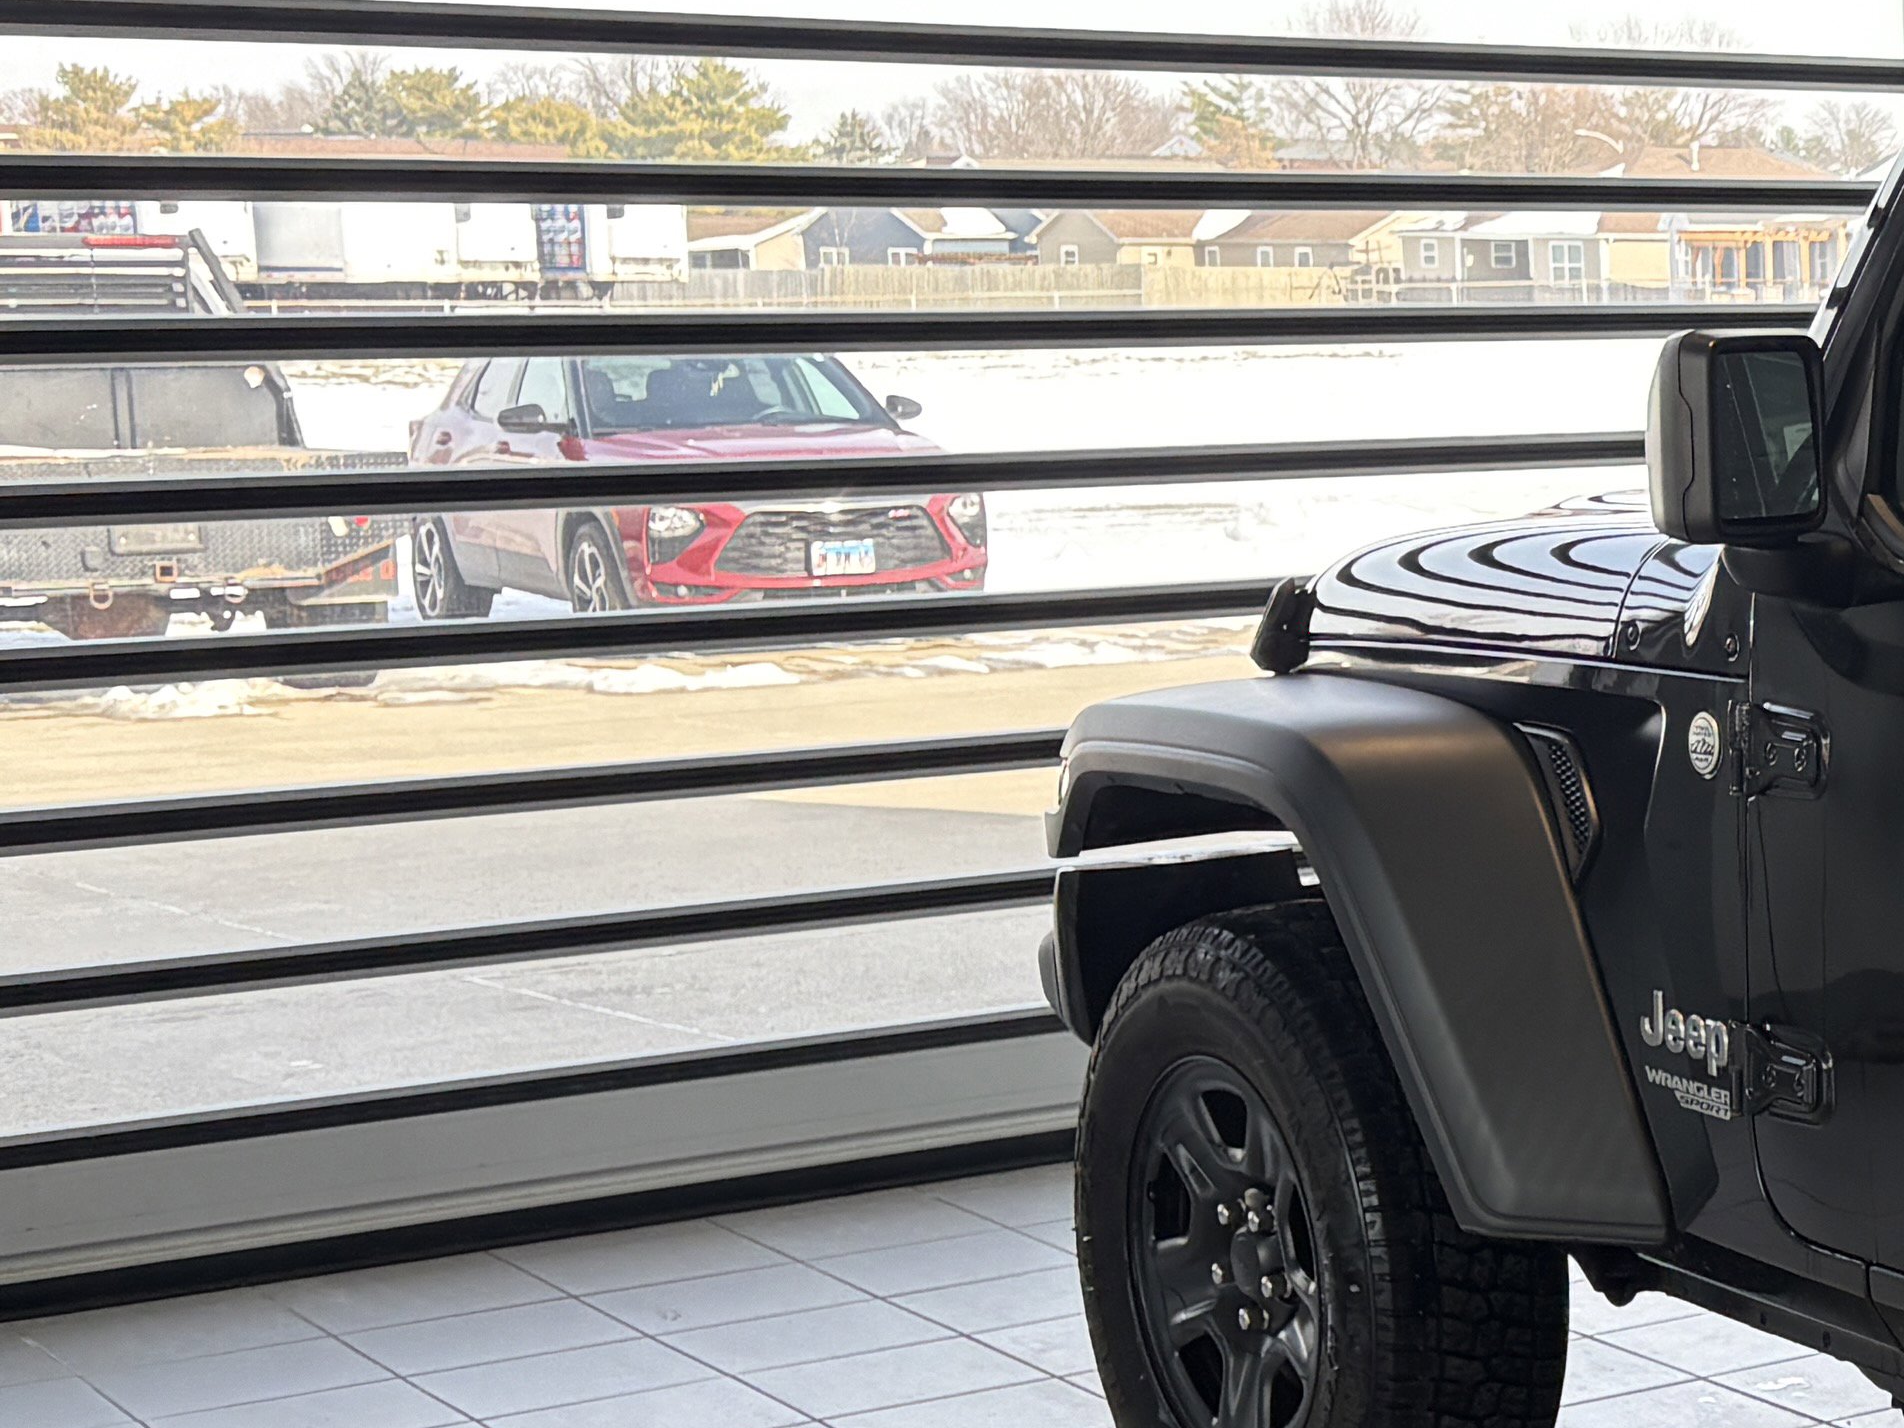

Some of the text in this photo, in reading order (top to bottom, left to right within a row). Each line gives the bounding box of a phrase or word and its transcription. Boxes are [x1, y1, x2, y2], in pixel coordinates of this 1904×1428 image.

[1640, 989, 1729, 1077] Jeep
[1644, 1065, 1731, 1106] WRANGLER
[1680, 1093, 1731, 1118] SPORT
